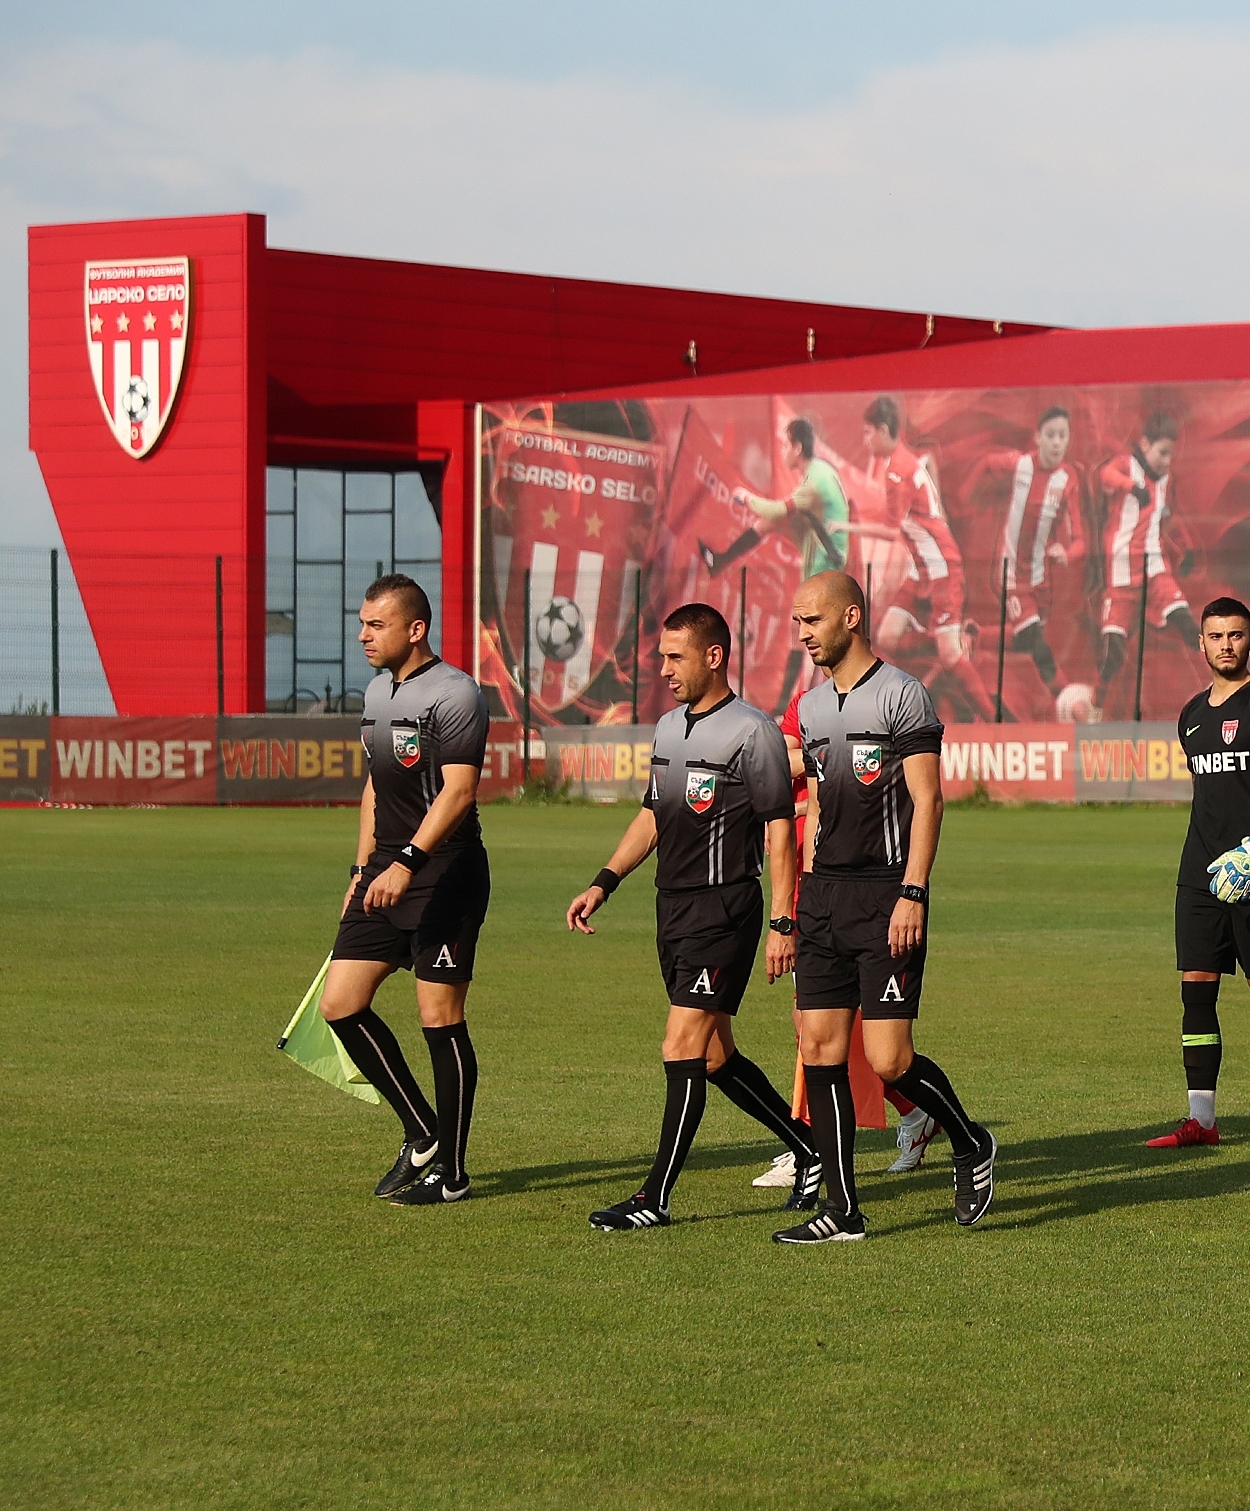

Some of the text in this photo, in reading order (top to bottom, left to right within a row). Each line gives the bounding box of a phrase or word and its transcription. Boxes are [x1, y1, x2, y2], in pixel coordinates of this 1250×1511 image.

[89, 264, 185, 281] ФУТБОЛНА АКАДЕМИЯ
[89, 283, 185, 305] ЦАРСКО СЕЛО
[506, 431, 660, 468] FOOTBALL ACADEMY
[501, 460, 656, 505] TSARSKO SELO
[56, 739, 212, 779] WINBET
[559, 742, 653, 782] WINBE
[940, 741, 1069, 782] WINBET
[432, 943, 457, 968] A
[689, 967, 715, 995] A
[879, 974, 905, 1002] A
